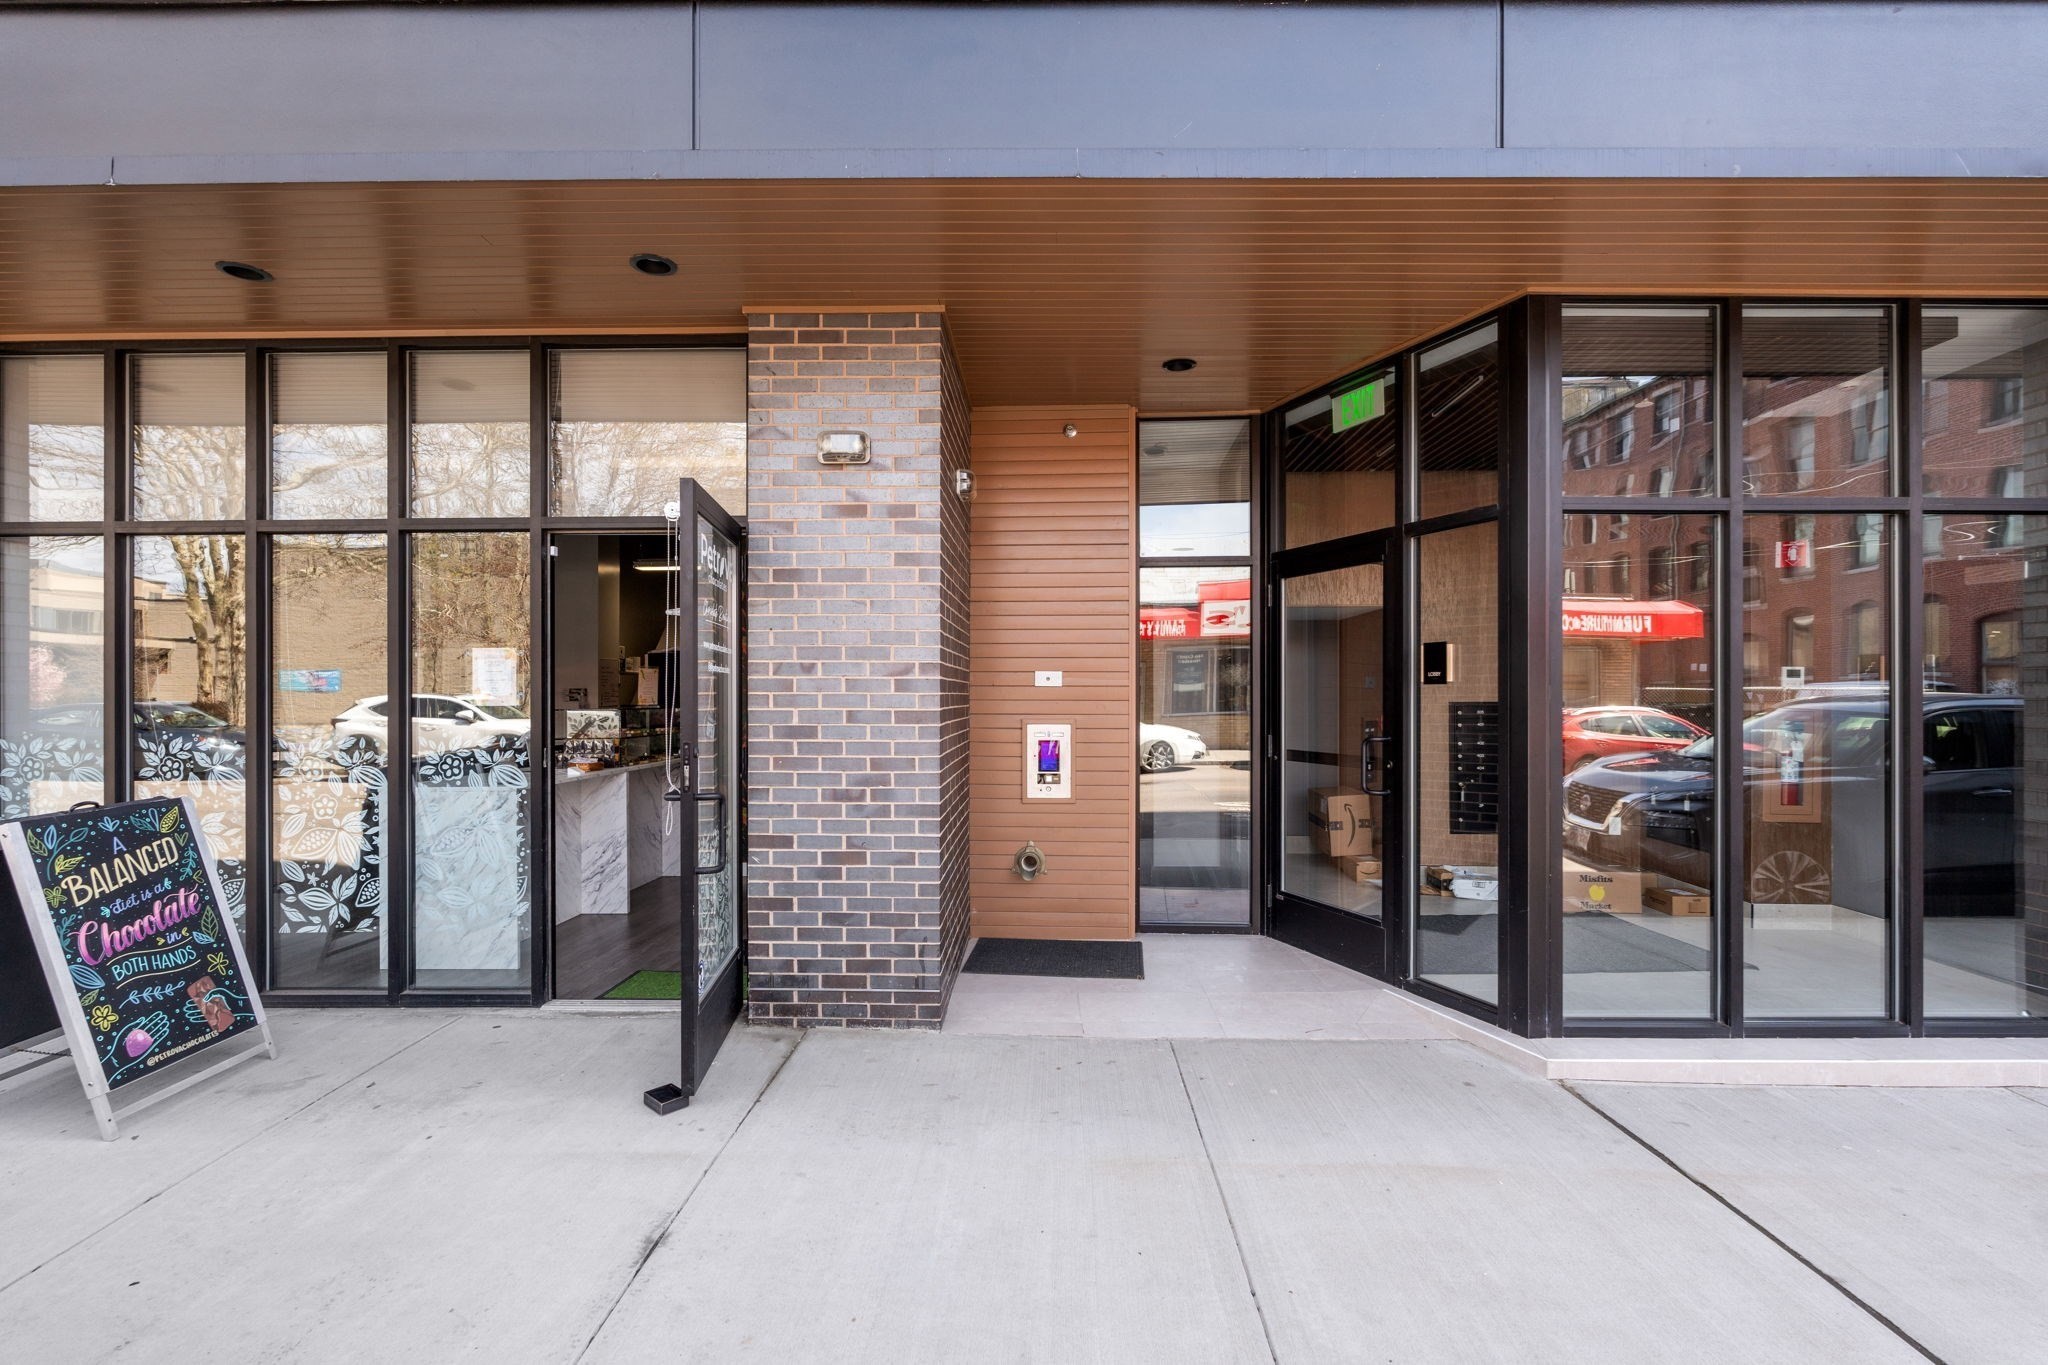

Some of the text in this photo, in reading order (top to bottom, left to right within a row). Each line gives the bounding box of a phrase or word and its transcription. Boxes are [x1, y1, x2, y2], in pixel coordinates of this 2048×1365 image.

[1341, 383, 1376, 426] EXIT
[112, 836, 127, 855] A
[60, 837, 179, 907] BALANCED
[1579, 874, 1613, 883] Misfits
[109, 883, 166, 914] diet is a
[1580, 901, 1612, 910] Market
[67, 883, 201, 966] Chocolate
[166, 931, 182, 944] in
[112, 945, 197, 981] BOTH HANDS
[146, 1029, 220, 1067] @PETROVACHOCOLATES
